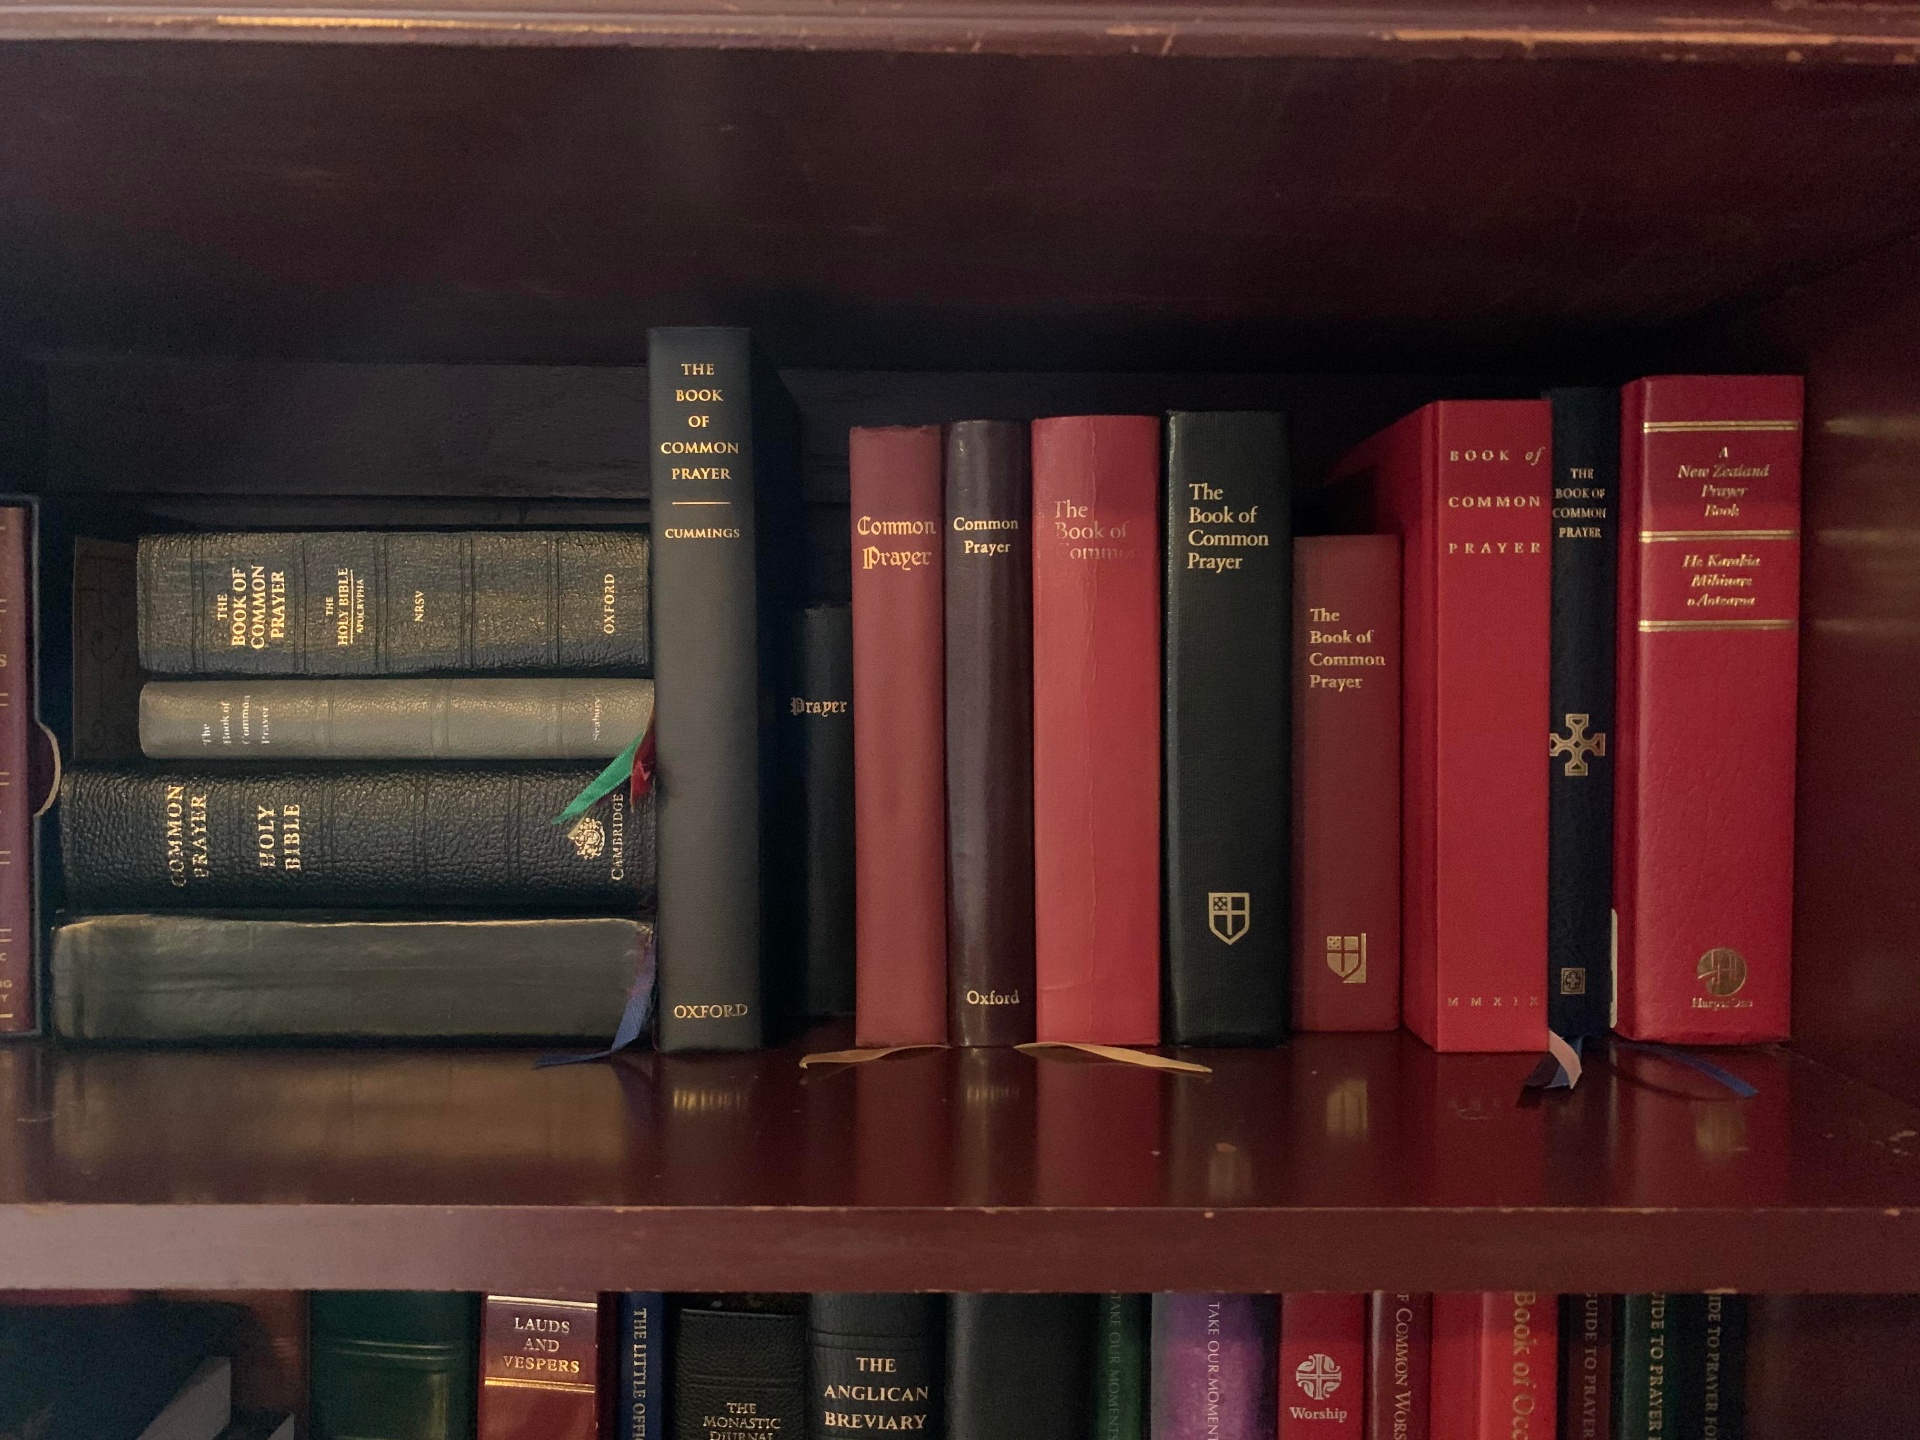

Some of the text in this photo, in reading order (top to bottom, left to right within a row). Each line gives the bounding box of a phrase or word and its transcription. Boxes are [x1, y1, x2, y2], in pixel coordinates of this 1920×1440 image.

[681, 363, 715, 376] THE
[675, 389, 724, 402] BOOK
[688, 415, 710, 428] OF
[660, 441, 739, 454] COMMON
[1449, 446, 1546, 466] BOOK of
[1718, 446, 1729, 458] A
[671, 468, 732, 480] PRAYER
[1570, 467, 1594, 479] THE
[1677, 464, 1710, 478] New
[1188, 483, 1224, 501] The
[1555, 487, 1606, 499] BOOK OF
[1701, 484, 1748, 500] Prayer
[1054, 499, 1088, 519] The
[1448, 496, 1540, 508] COMMON
[1704, 503, 1740, 517] Book
[1188, 505, 1259, 524] Book of
[1553, 507, 1607, 519] COMMON
[664, 528, 740, 539] CUMMINGS
[857, 515, 937, 536] Common
[953, 517, 1019, 531] Common
[1055, 520, 1130, 540] Book of
[1558, 527, 1602, 538] PRAYER
[964, 540, 1011, 556] Prayer
[1188, 530, 1270, 547] Common
[1449, 542, 1541, 554] PRAYER
[862, 545, 933, 571] Prayer
[1187, 552, 1243, 573] Prayer
[1682, 554, 1703, 568] He
[217, 593, 228, 621] THE
[231, 566, 247, 646] BOOK OF
[251, 565, 266, 649] COMMON
[270, 571, 285, 639] PRAYER
[325, 597, 334, 616] THE
[337, 567, 350, 646] HOLY BIBLE
[356, 579, 365, 634] APOCRYPHA
[414, 590, 425, 623] NRSV
[603, 573, 616, 635] OXFORD
[1309, 607, 1340, 622] The
[1309, 629, 1375, 644] Book of
[1308, 652, 1386, 666] Common
[1309, 674, 1364, 692] Prayer
[790, 697, 848, 718] Prayer
[219, 701, 232, 744] Book of
[241, 695, 251, 744] Common
[261, 706, 271, 744] Prayer
[201, 723, 212, 746] The
[166, 784, 187, 888] COMMON
[190, 793, 210, 878] PRAYER
[257, 804, 277, 869] HOLY
[283, 803, 302, 871] BIBLE
[966, 990, 1020, 1005] Oxford
[673, 1004, 748, 1019] OXFORD
[1109, 1296, 1121, 1327] TAKE
[1207, 1302, 1220, 1336] TAKE
[514, 1317, 570, 1334] LAUDS
[523, 1337, 560, 1352] AND
[1707, 1326, 1720, 1348] TO
[1108, 1332, 1121, 1364] OUR
[1207, 1340, 1220, 1373] OUR
[1650, 1334, 1664, 1360] TO
[502, 1355, 580, 1374] VESPERS
[856, 1357, 897, 1373] THE
[1584, 1346, 1597, 1370] TO
[632, 1307, 647, 1440] THE LITTLE OFFI
[1512, 1362, 1537, 1388] of
[1705, 1352, 1719, 1412] PRAYER
[823, 1384, 929, 1402] ANGLICAN
[1648, 1364, 1663, 1432] PRAYER
[726, 1402, 757, 1414] THE
[1290, 1407, 1348, 1423] Worship
[1583, 1374, 1597, 1438] PRAYER
[702, 1415, 781, 1429] MONASTIC
[824, 1410, 927, 1431] BREVIARY
